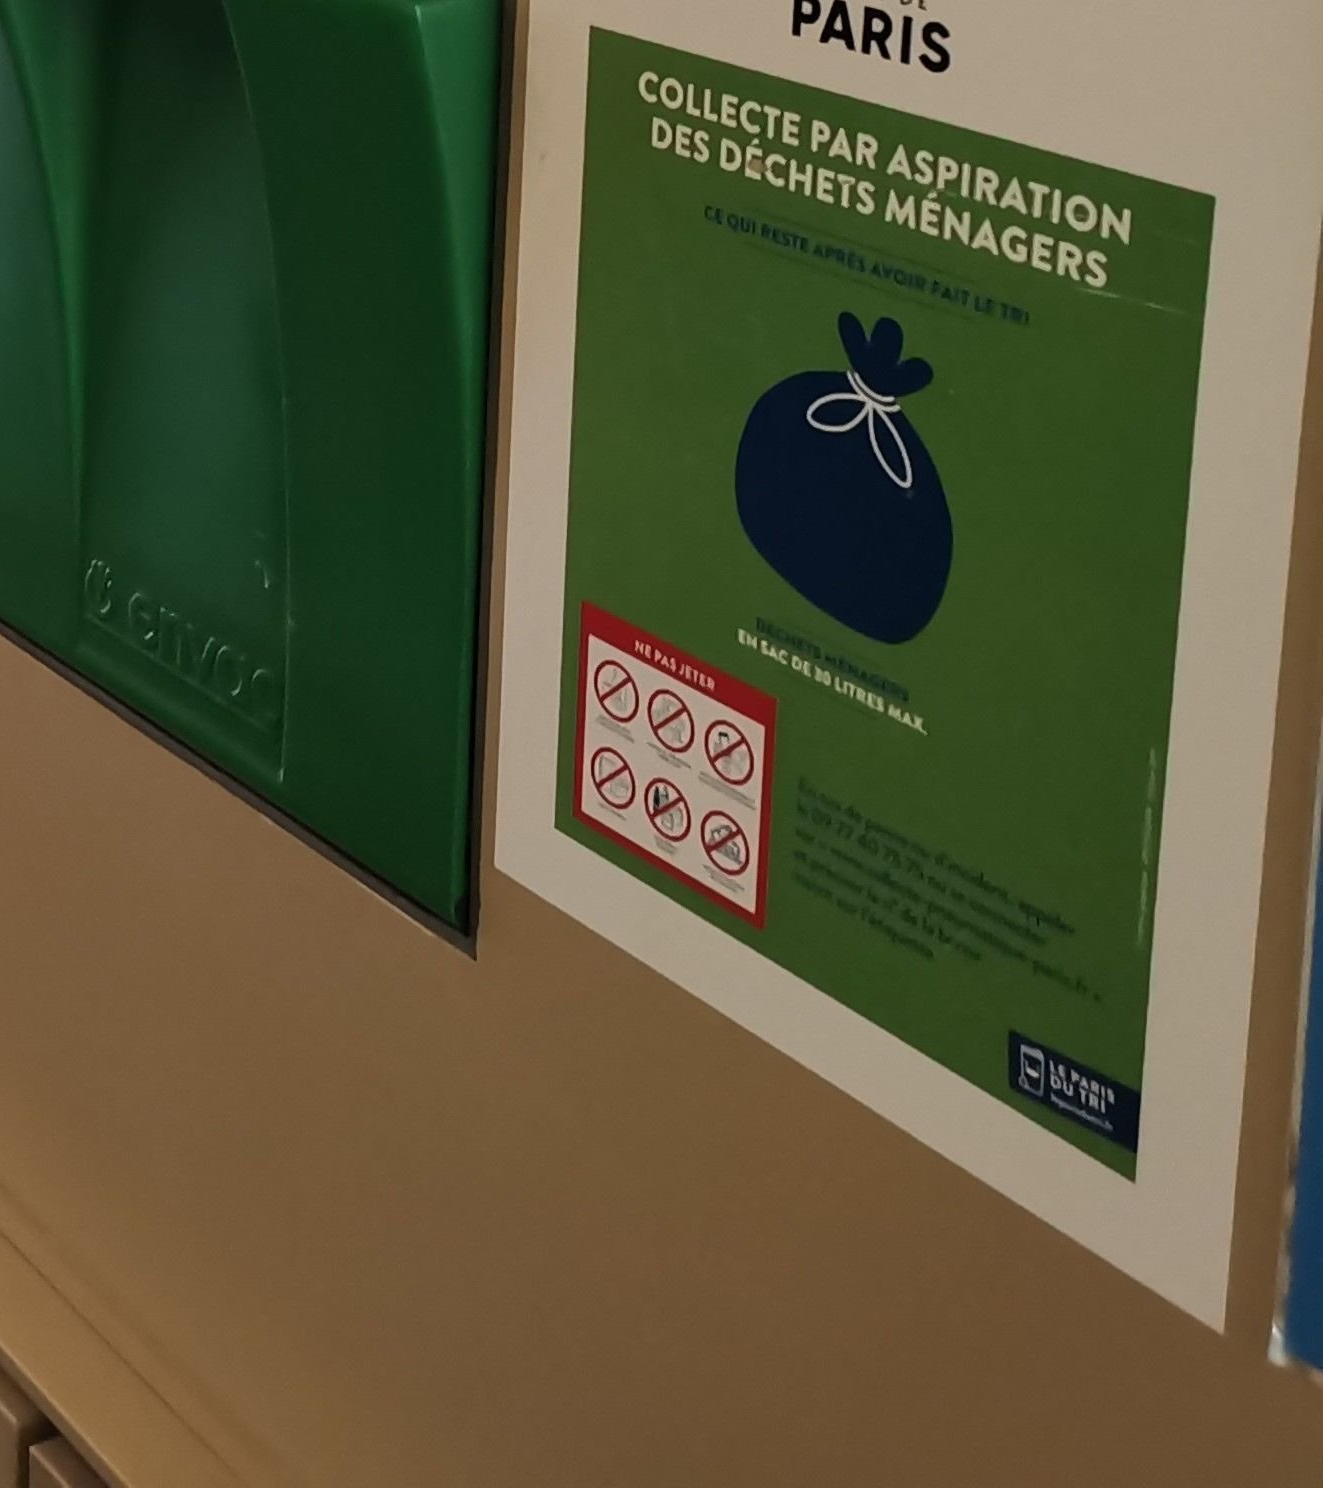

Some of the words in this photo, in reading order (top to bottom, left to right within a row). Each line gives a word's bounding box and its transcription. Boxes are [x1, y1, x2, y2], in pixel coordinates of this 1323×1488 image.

[638, 71, 800, 147] COLLECTE
[810, 119, 879, 170] PAR
[886, 144, 1132, 246] ASPIRATION
[651, 116, 711, 164] DES
[720, 138, 876, 216] DÉCHETS
[885, 188, 1109, 289] MÉNAGERS
[705, 205, 723, 225] CE
[727, 214, 756, 236] QUI
[760, 223, 809, 252] RESTE
[871, 261, 928, 291] AVOIR
[930, 280, 970, 305] FAIT
[974, 294, 994, 313] LE
[635, 639, 651, 659] NE
[654, 649, 676, 672] PAS
[679, 663, 715, 692] JETER
[738, 627, 758, 649] EN
[760, 639, 788, 665] SAC
[791, 654, 812, 678] DE
[834, 676, 885, 712] LITRES
[1049, 1059, 1067, 1080] LE
[1070, 1068, 1115, 1105] PARIS
[1050, 1073, 1074, 1097] DU
[1078, 1087, 1106, 1114] TRI
